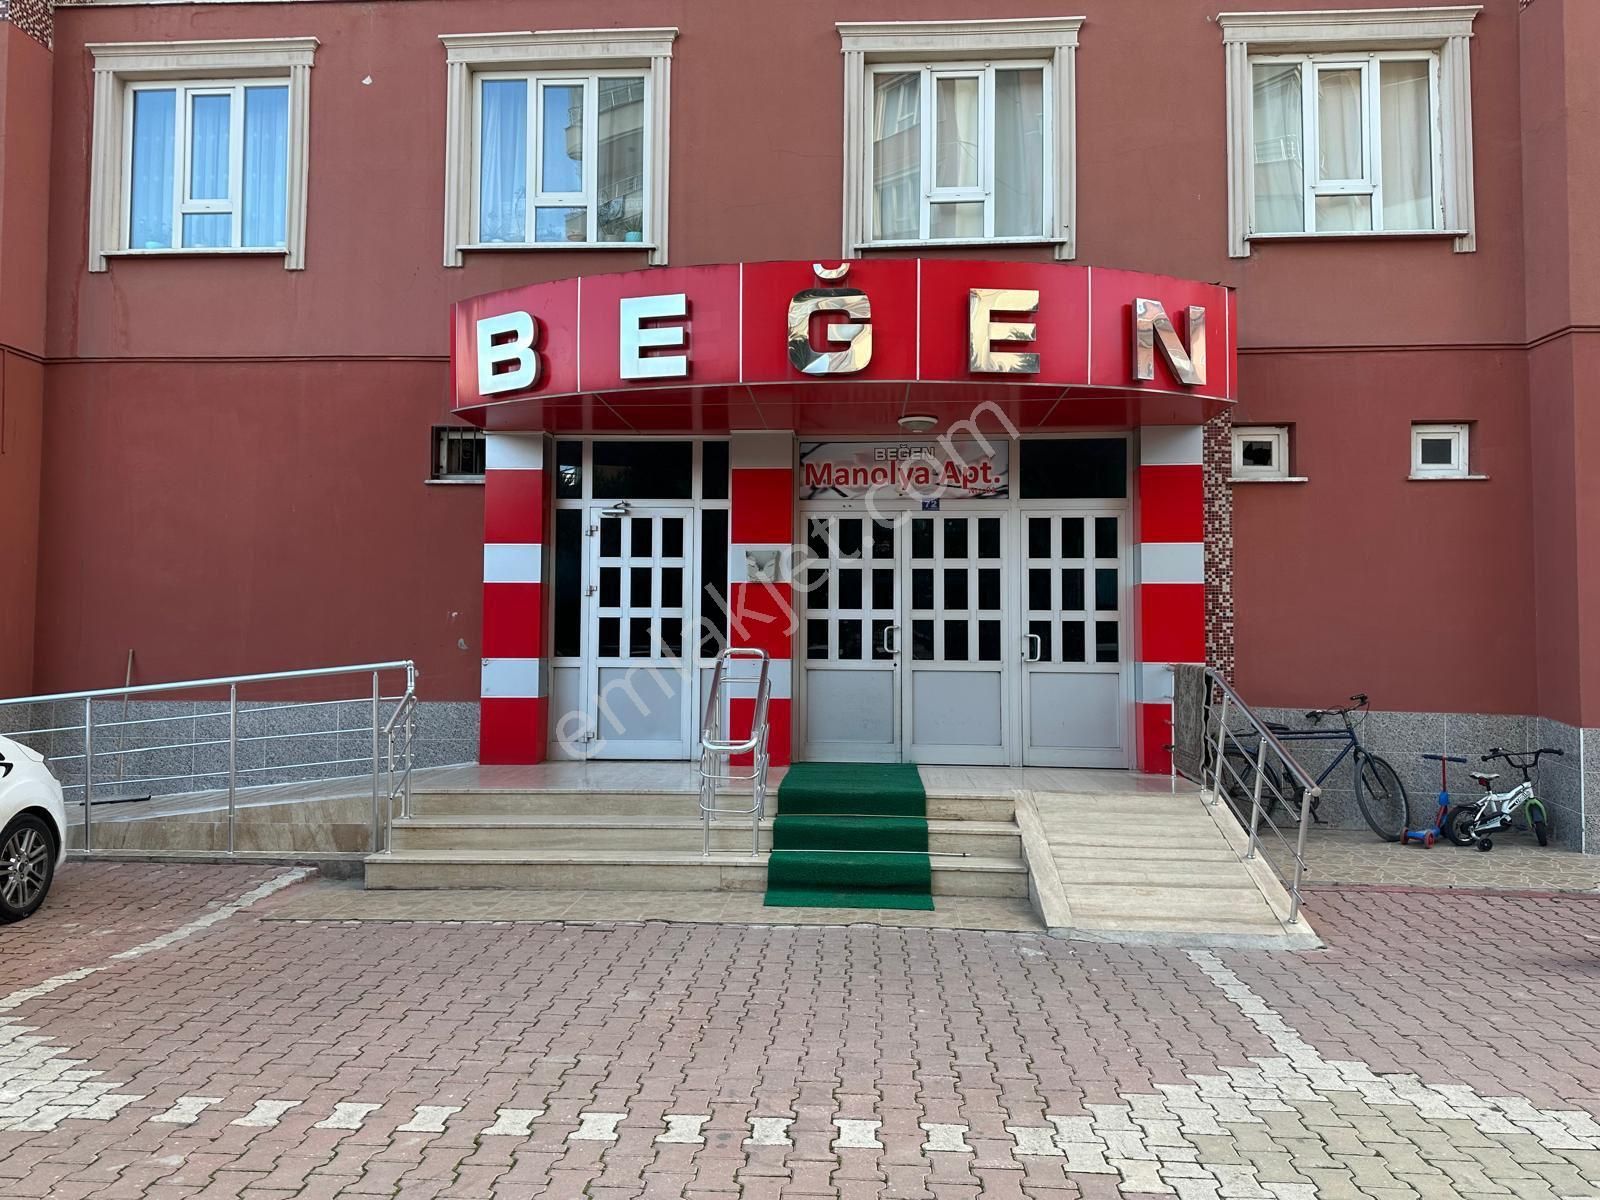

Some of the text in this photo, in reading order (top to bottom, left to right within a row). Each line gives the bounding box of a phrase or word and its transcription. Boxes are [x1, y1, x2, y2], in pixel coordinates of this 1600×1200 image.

[477, 262, 1206, 395] BEĞEN
[874, 443, 936, 462] BEĞEN
[805, 459, 1000, 490] Manolya Apt.
[923, 500, 938, 508] 72
